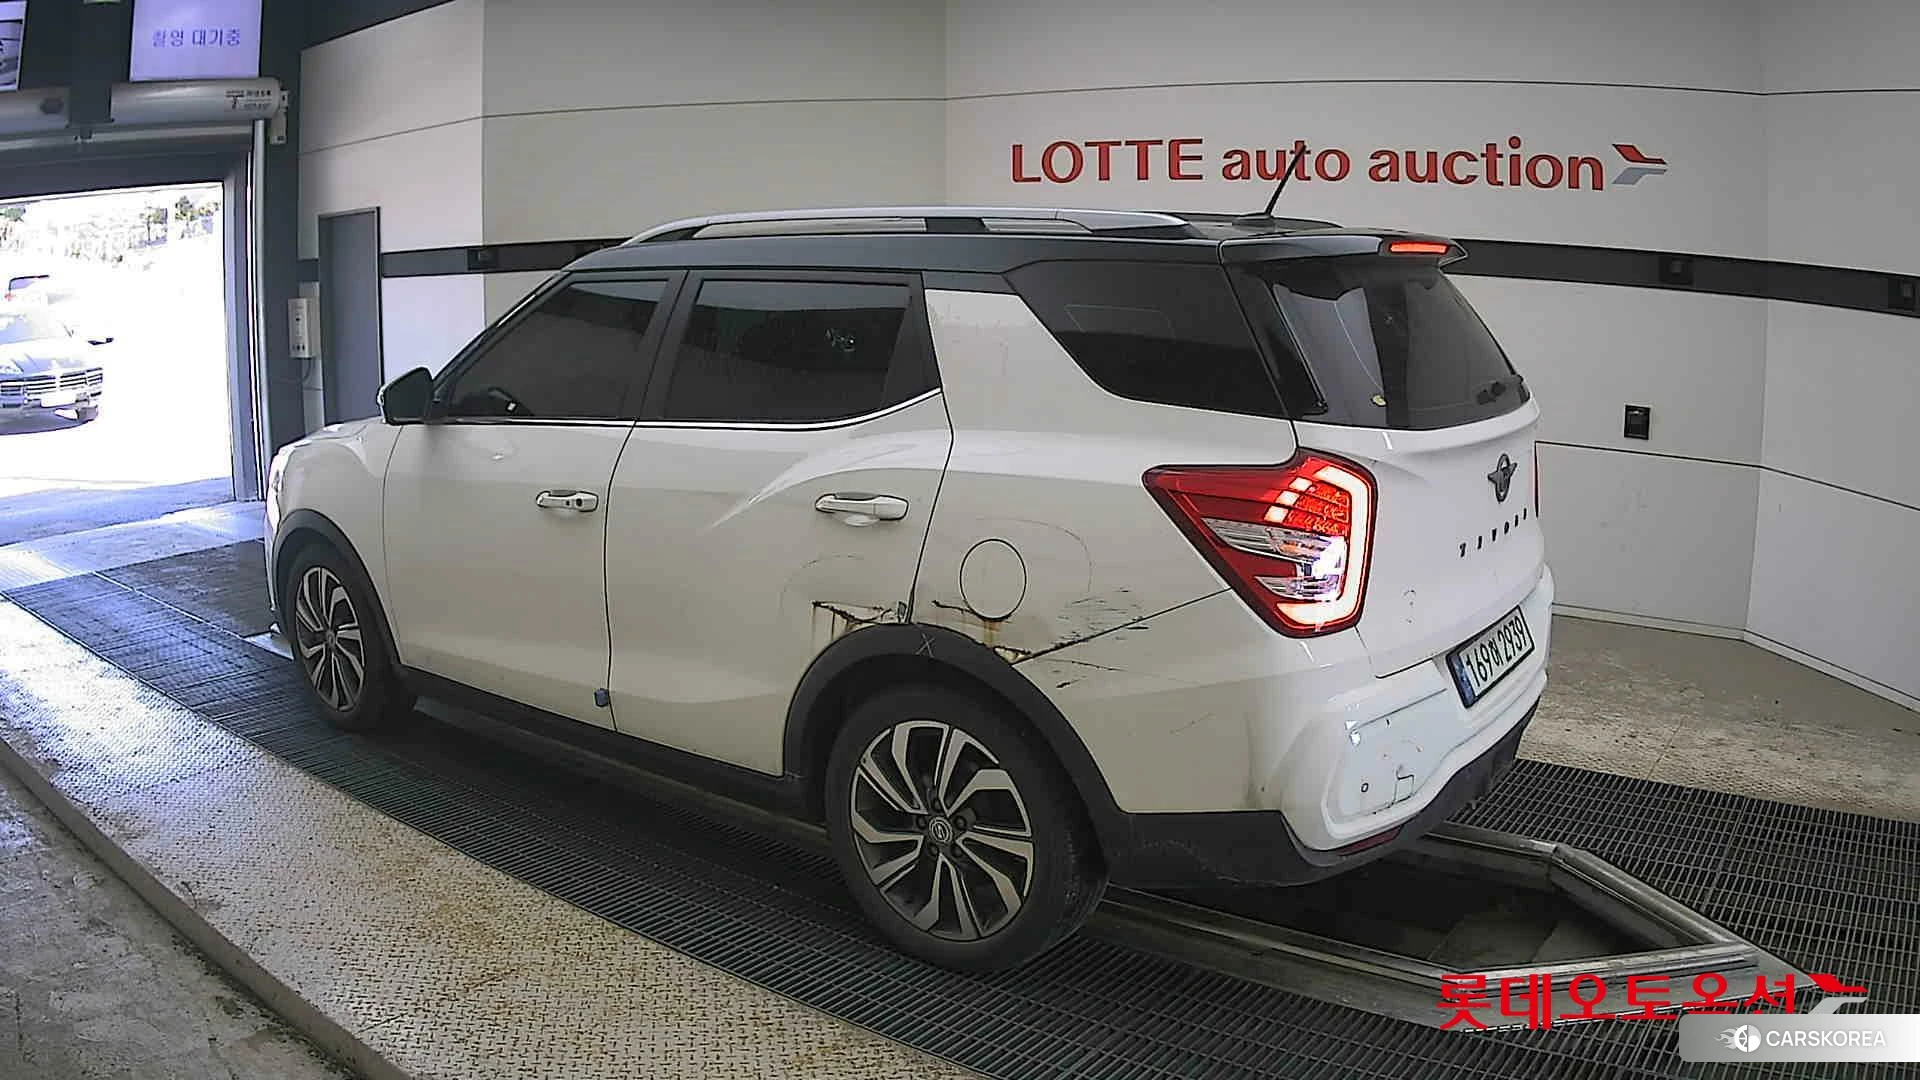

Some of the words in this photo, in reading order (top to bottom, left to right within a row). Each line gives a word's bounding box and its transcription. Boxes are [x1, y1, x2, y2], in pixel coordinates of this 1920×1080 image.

[191, 28, 241, 47] 대기중
[1011, 138, 1204, 184] LOTTE
[1222, 140, 1351, 182] auto
[1368, 136, 1604, 190] auction
[1498, 616, 1527, 662] 2939
